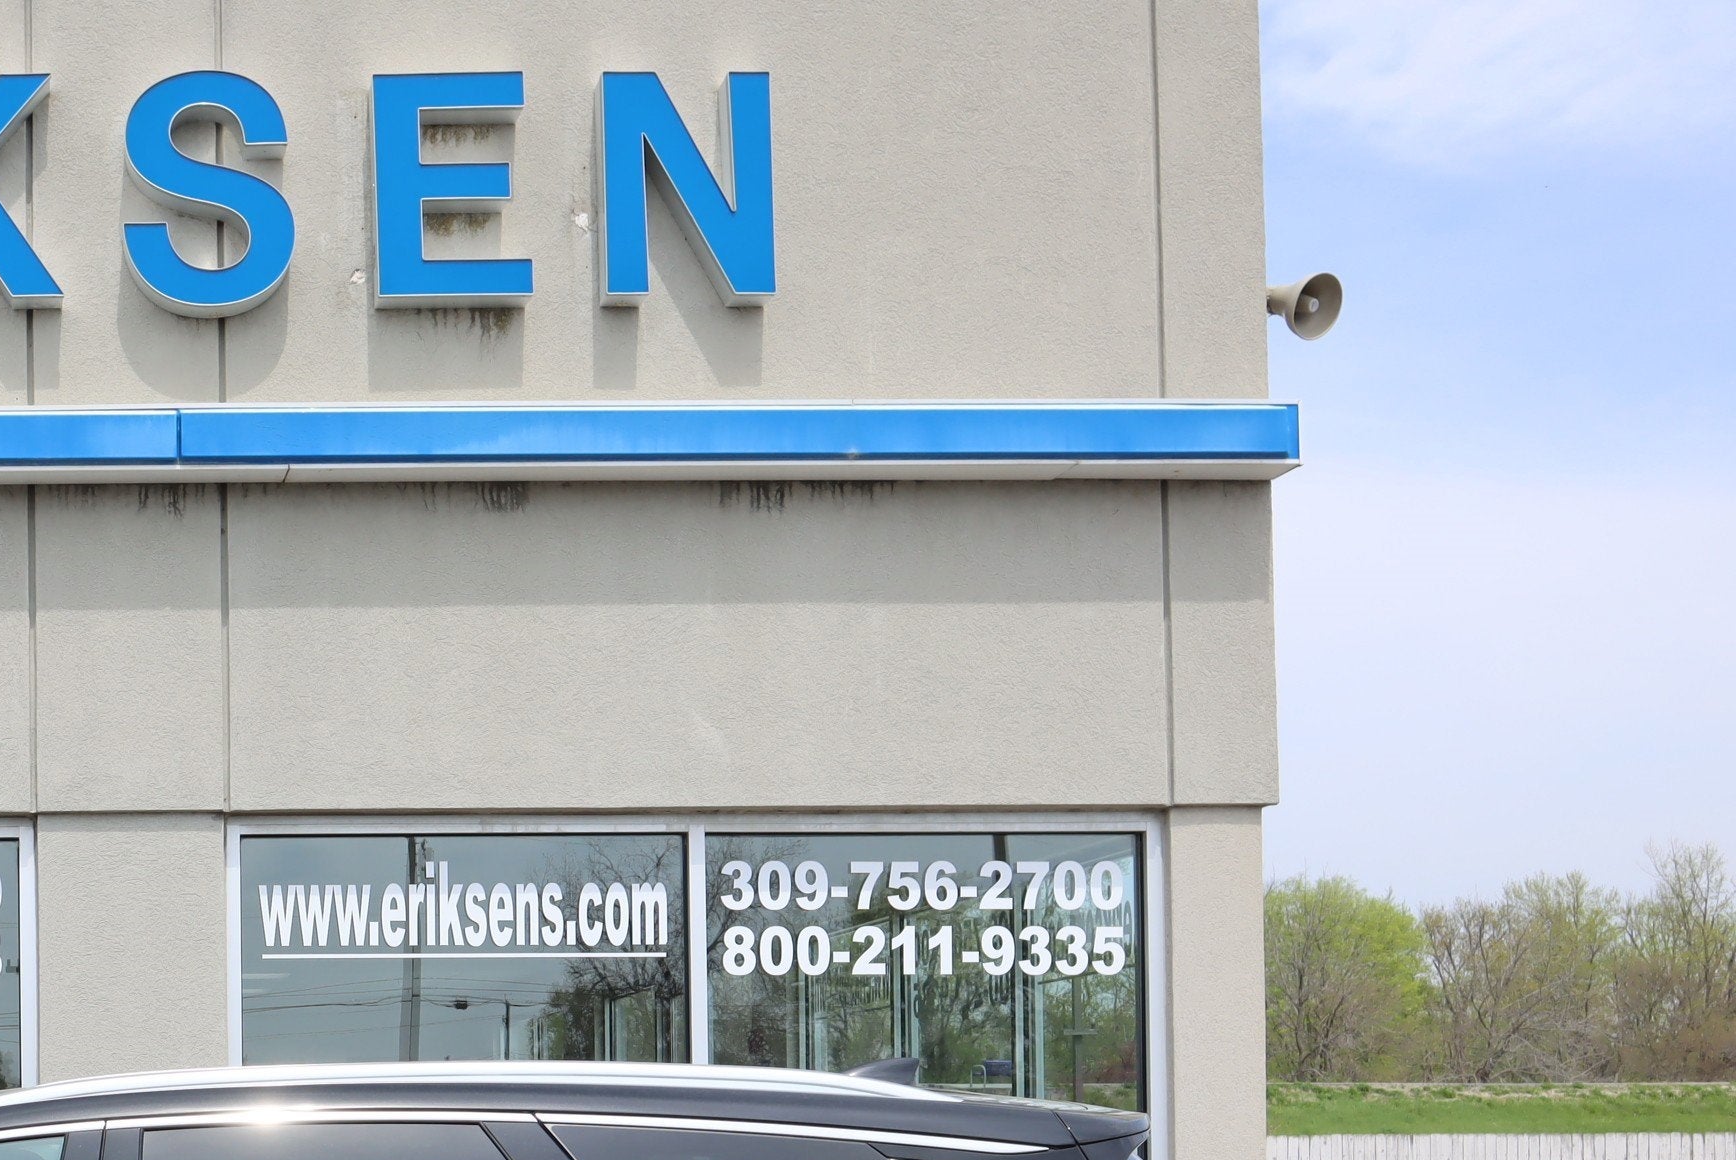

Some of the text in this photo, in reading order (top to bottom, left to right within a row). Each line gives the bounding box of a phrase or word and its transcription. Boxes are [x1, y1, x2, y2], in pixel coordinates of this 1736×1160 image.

[261, 861, 668, 948] www.eriksens.com
[720, 860, 1124, 911] 309-756-2700
[721, 925, 1126, 976] 800-211-9335
